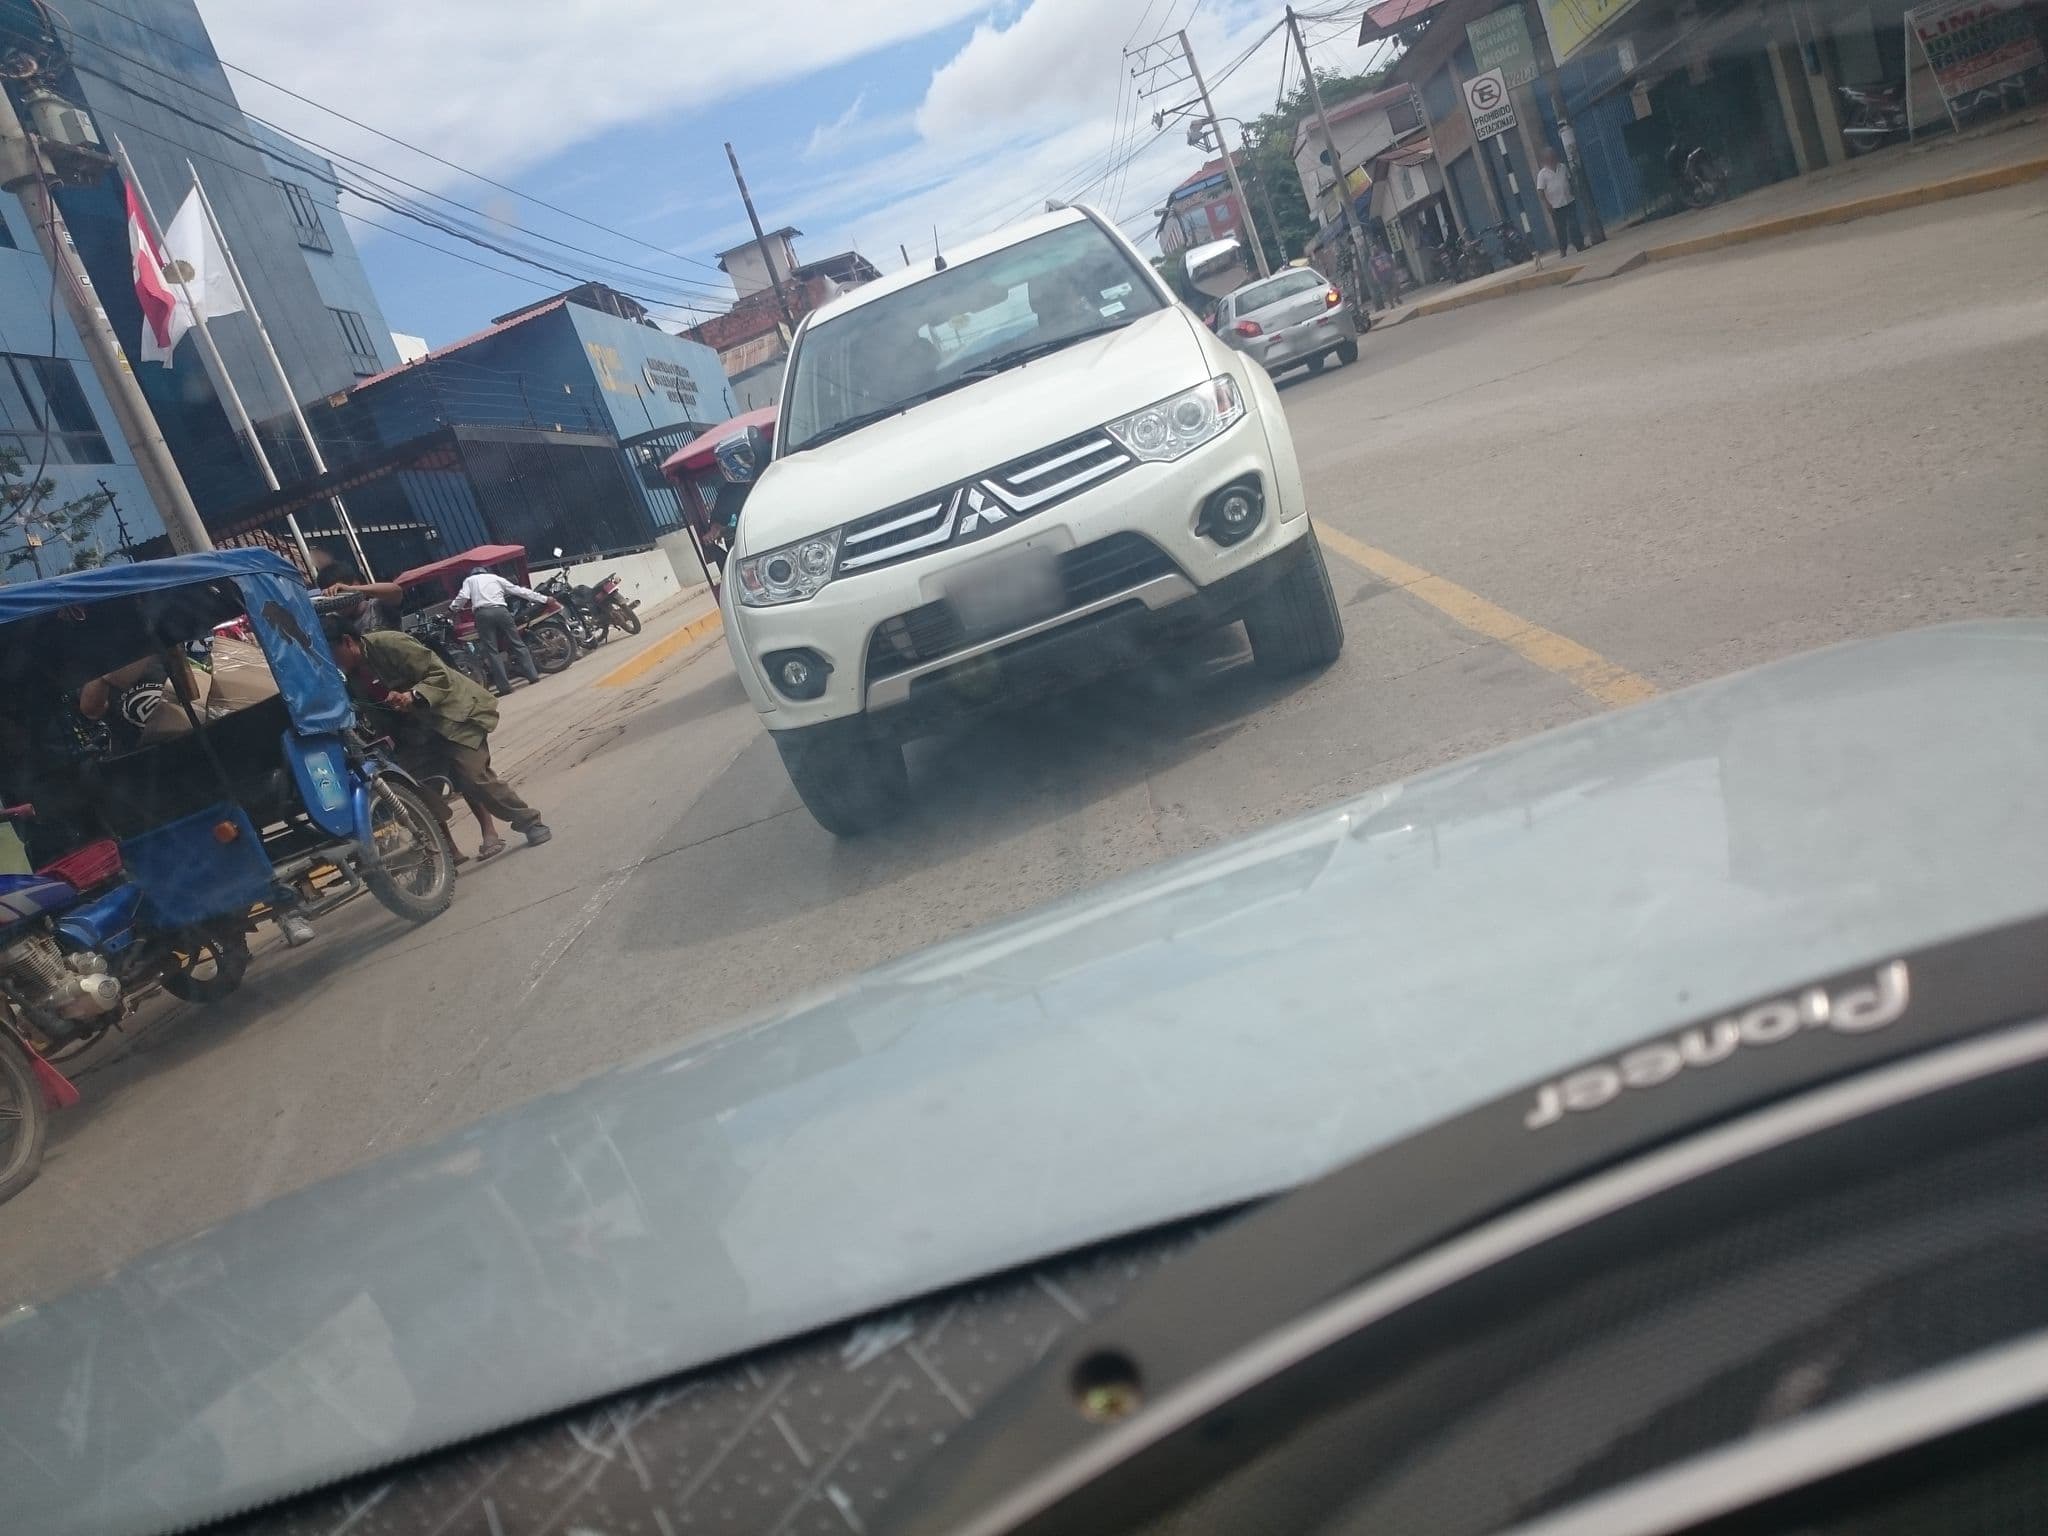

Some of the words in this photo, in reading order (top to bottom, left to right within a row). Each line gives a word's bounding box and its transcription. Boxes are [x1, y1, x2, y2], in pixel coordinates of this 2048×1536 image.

[1473, 104, 1512, 127] PROHIBIDO
[1476, 115, 1515, 138] ESTACIONAR
[1524, 959, 1910, 1130] Pioneer
